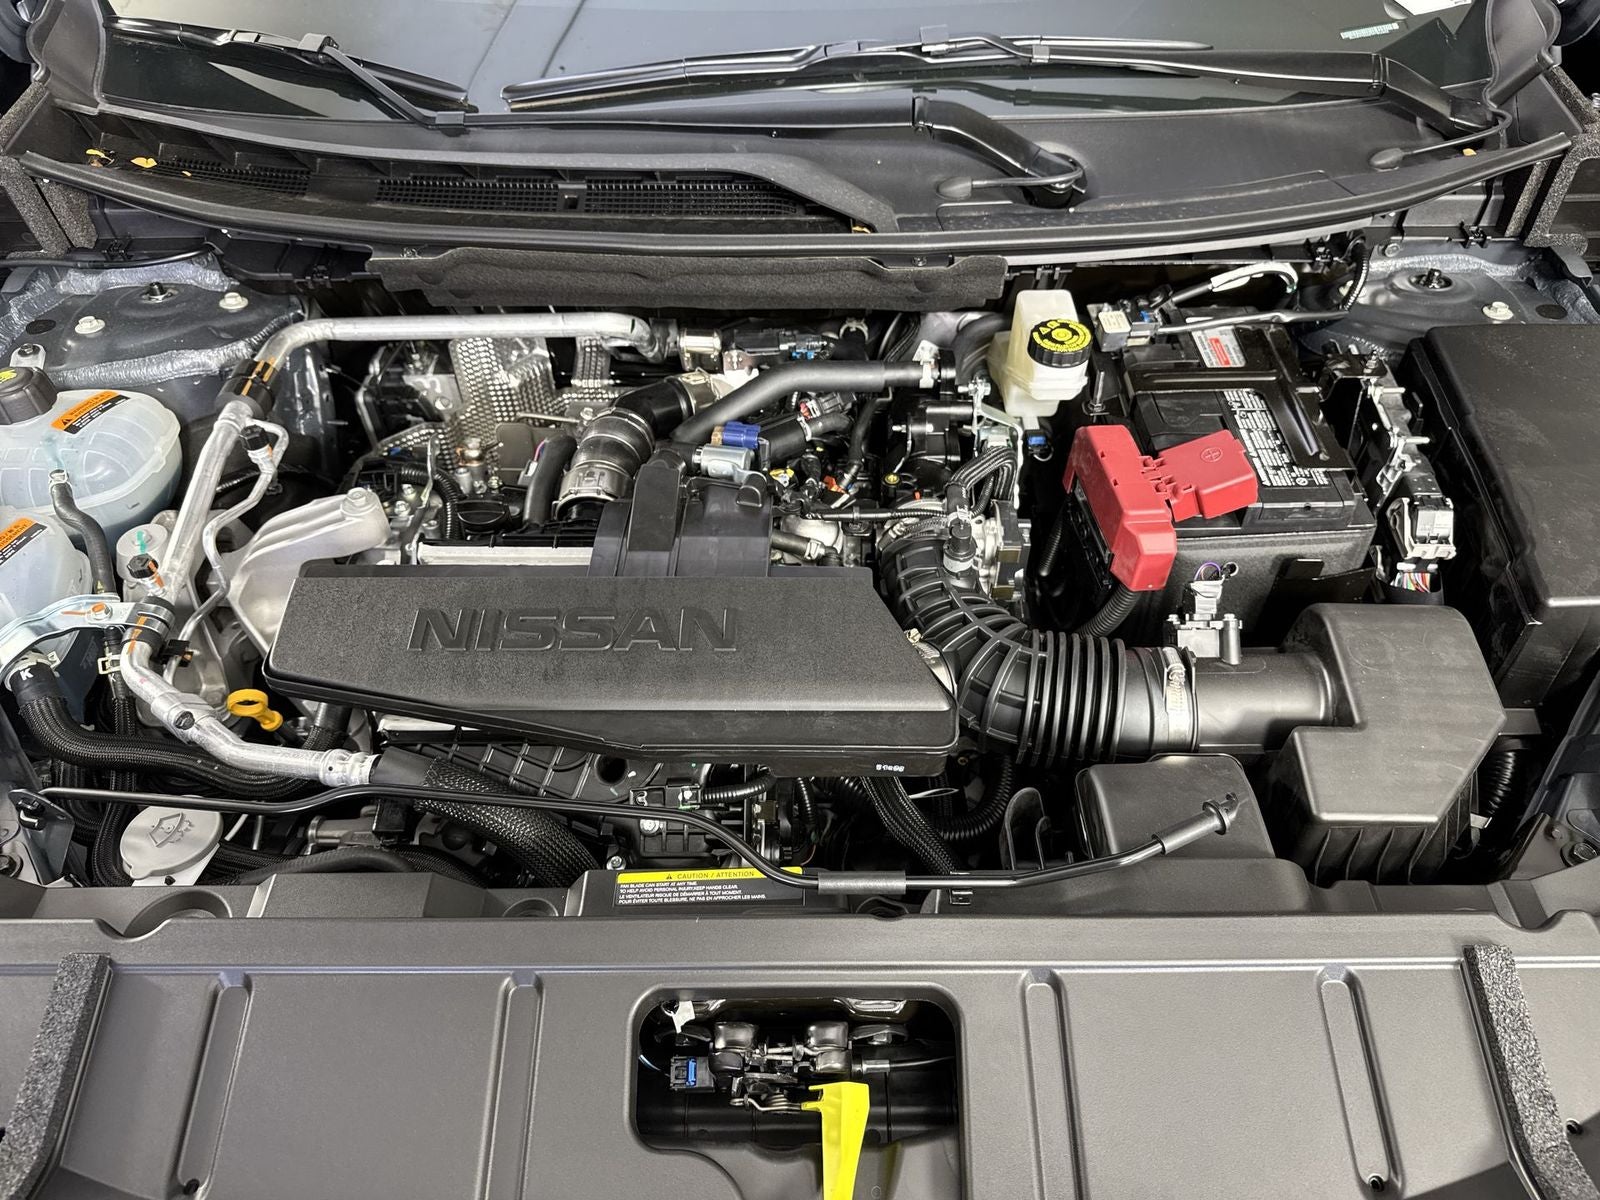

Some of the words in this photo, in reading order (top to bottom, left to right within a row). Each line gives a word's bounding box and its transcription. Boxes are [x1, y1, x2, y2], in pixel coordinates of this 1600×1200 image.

[407, 608, 736, 651] NISSAN
[20, 667, 33, 681] K
[677, 872, 709, 880] CAUTION
[716, 870, 755, 878] ATTENTION
